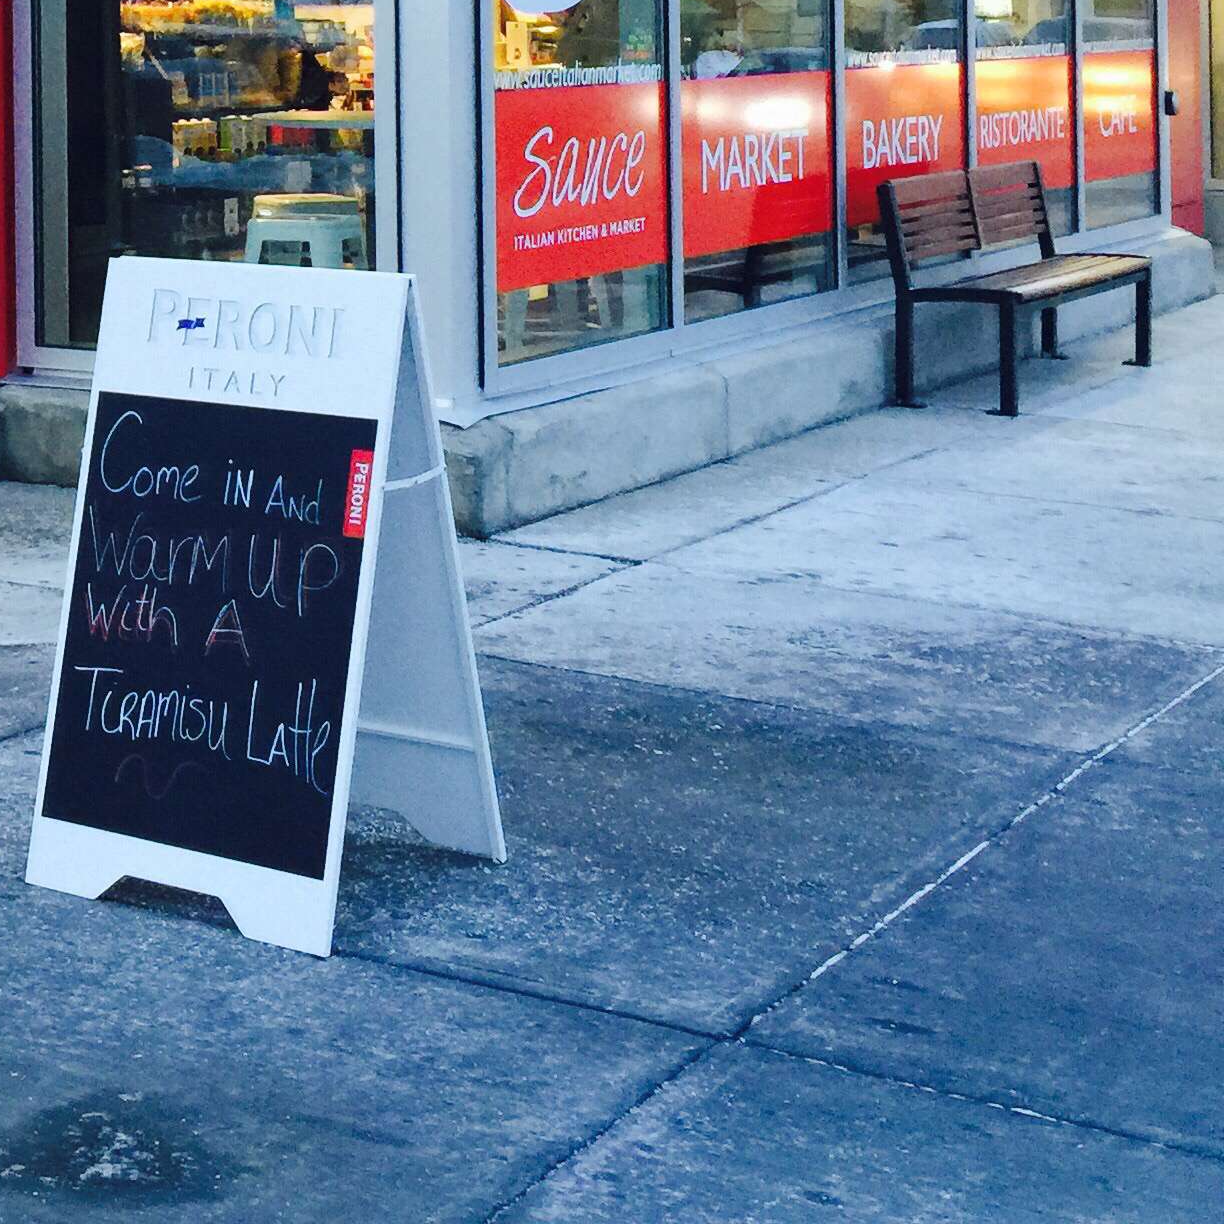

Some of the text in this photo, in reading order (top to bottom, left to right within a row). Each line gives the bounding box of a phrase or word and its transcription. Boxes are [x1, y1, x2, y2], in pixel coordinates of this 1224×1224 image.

[862, 114, 943, 169] BAKERY
[980, 106, 1065, 149] RISTORANTE
[513, 126, 645, 218] Sauce
[700, 128, 809, 194] MARKET
[514, 216, 646, 251] ITALIAN KITCHEN & MARKET
[146, 288, 346, 359] PERONI
[188, 366, 286, 397] ITALY
[100, 410, 204, 503] Come
[348, 461, 370, 527] PERONI
[85, 581, 252, 662] With A
